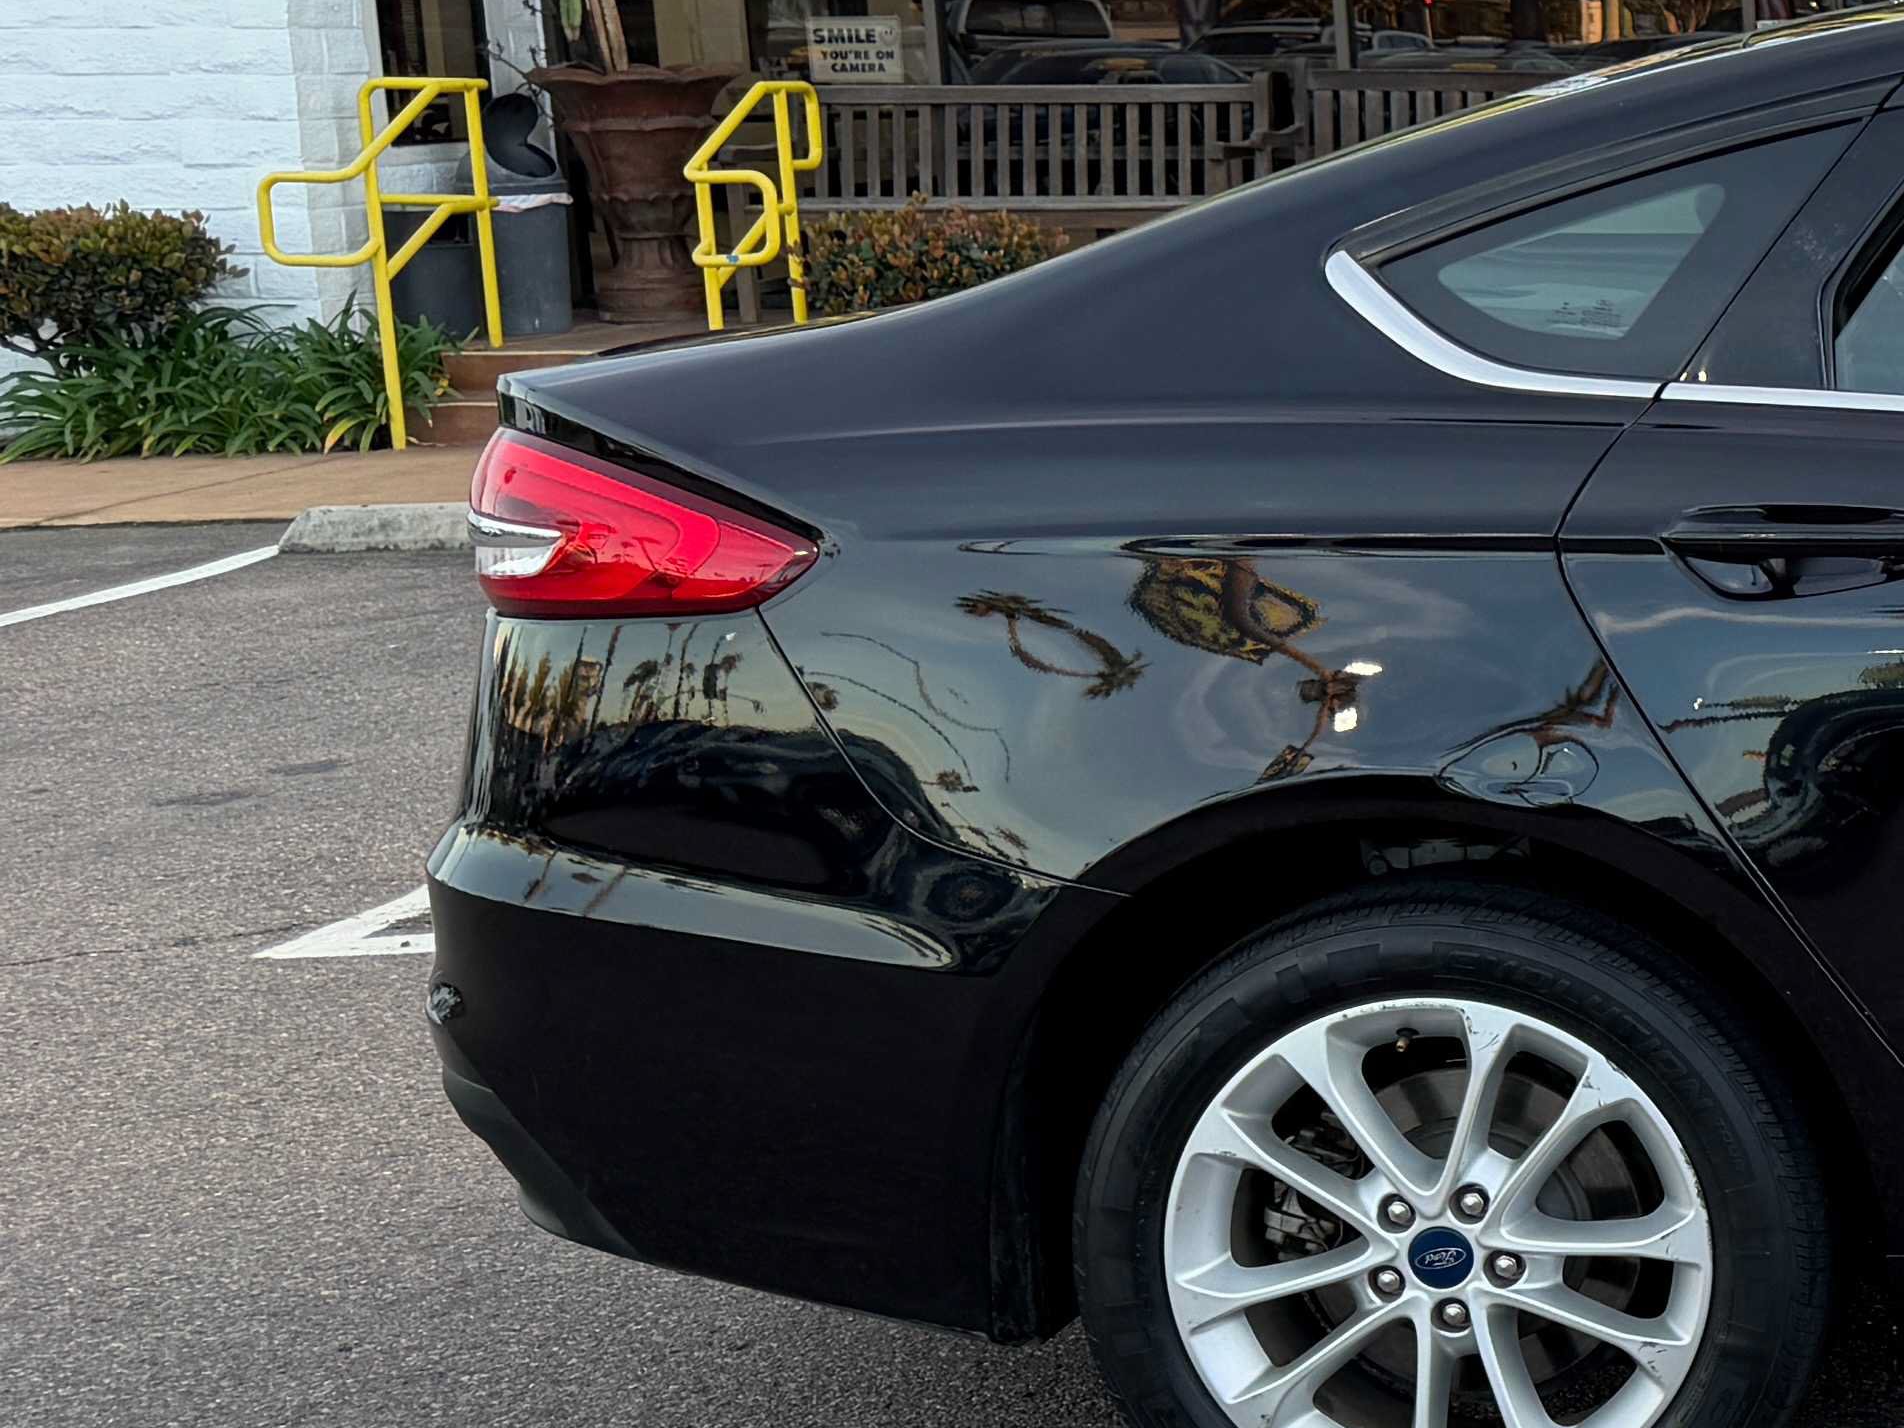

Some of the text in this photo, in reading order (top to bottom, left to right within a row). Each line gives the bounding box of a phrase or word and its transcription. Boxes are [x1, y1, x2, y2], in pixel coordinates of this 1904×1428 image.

[813, 27, 876, 44] SMILE
[820, 50, 895, 61] YOU'RE ON
[831, 62, 886, 73] CAMERA
